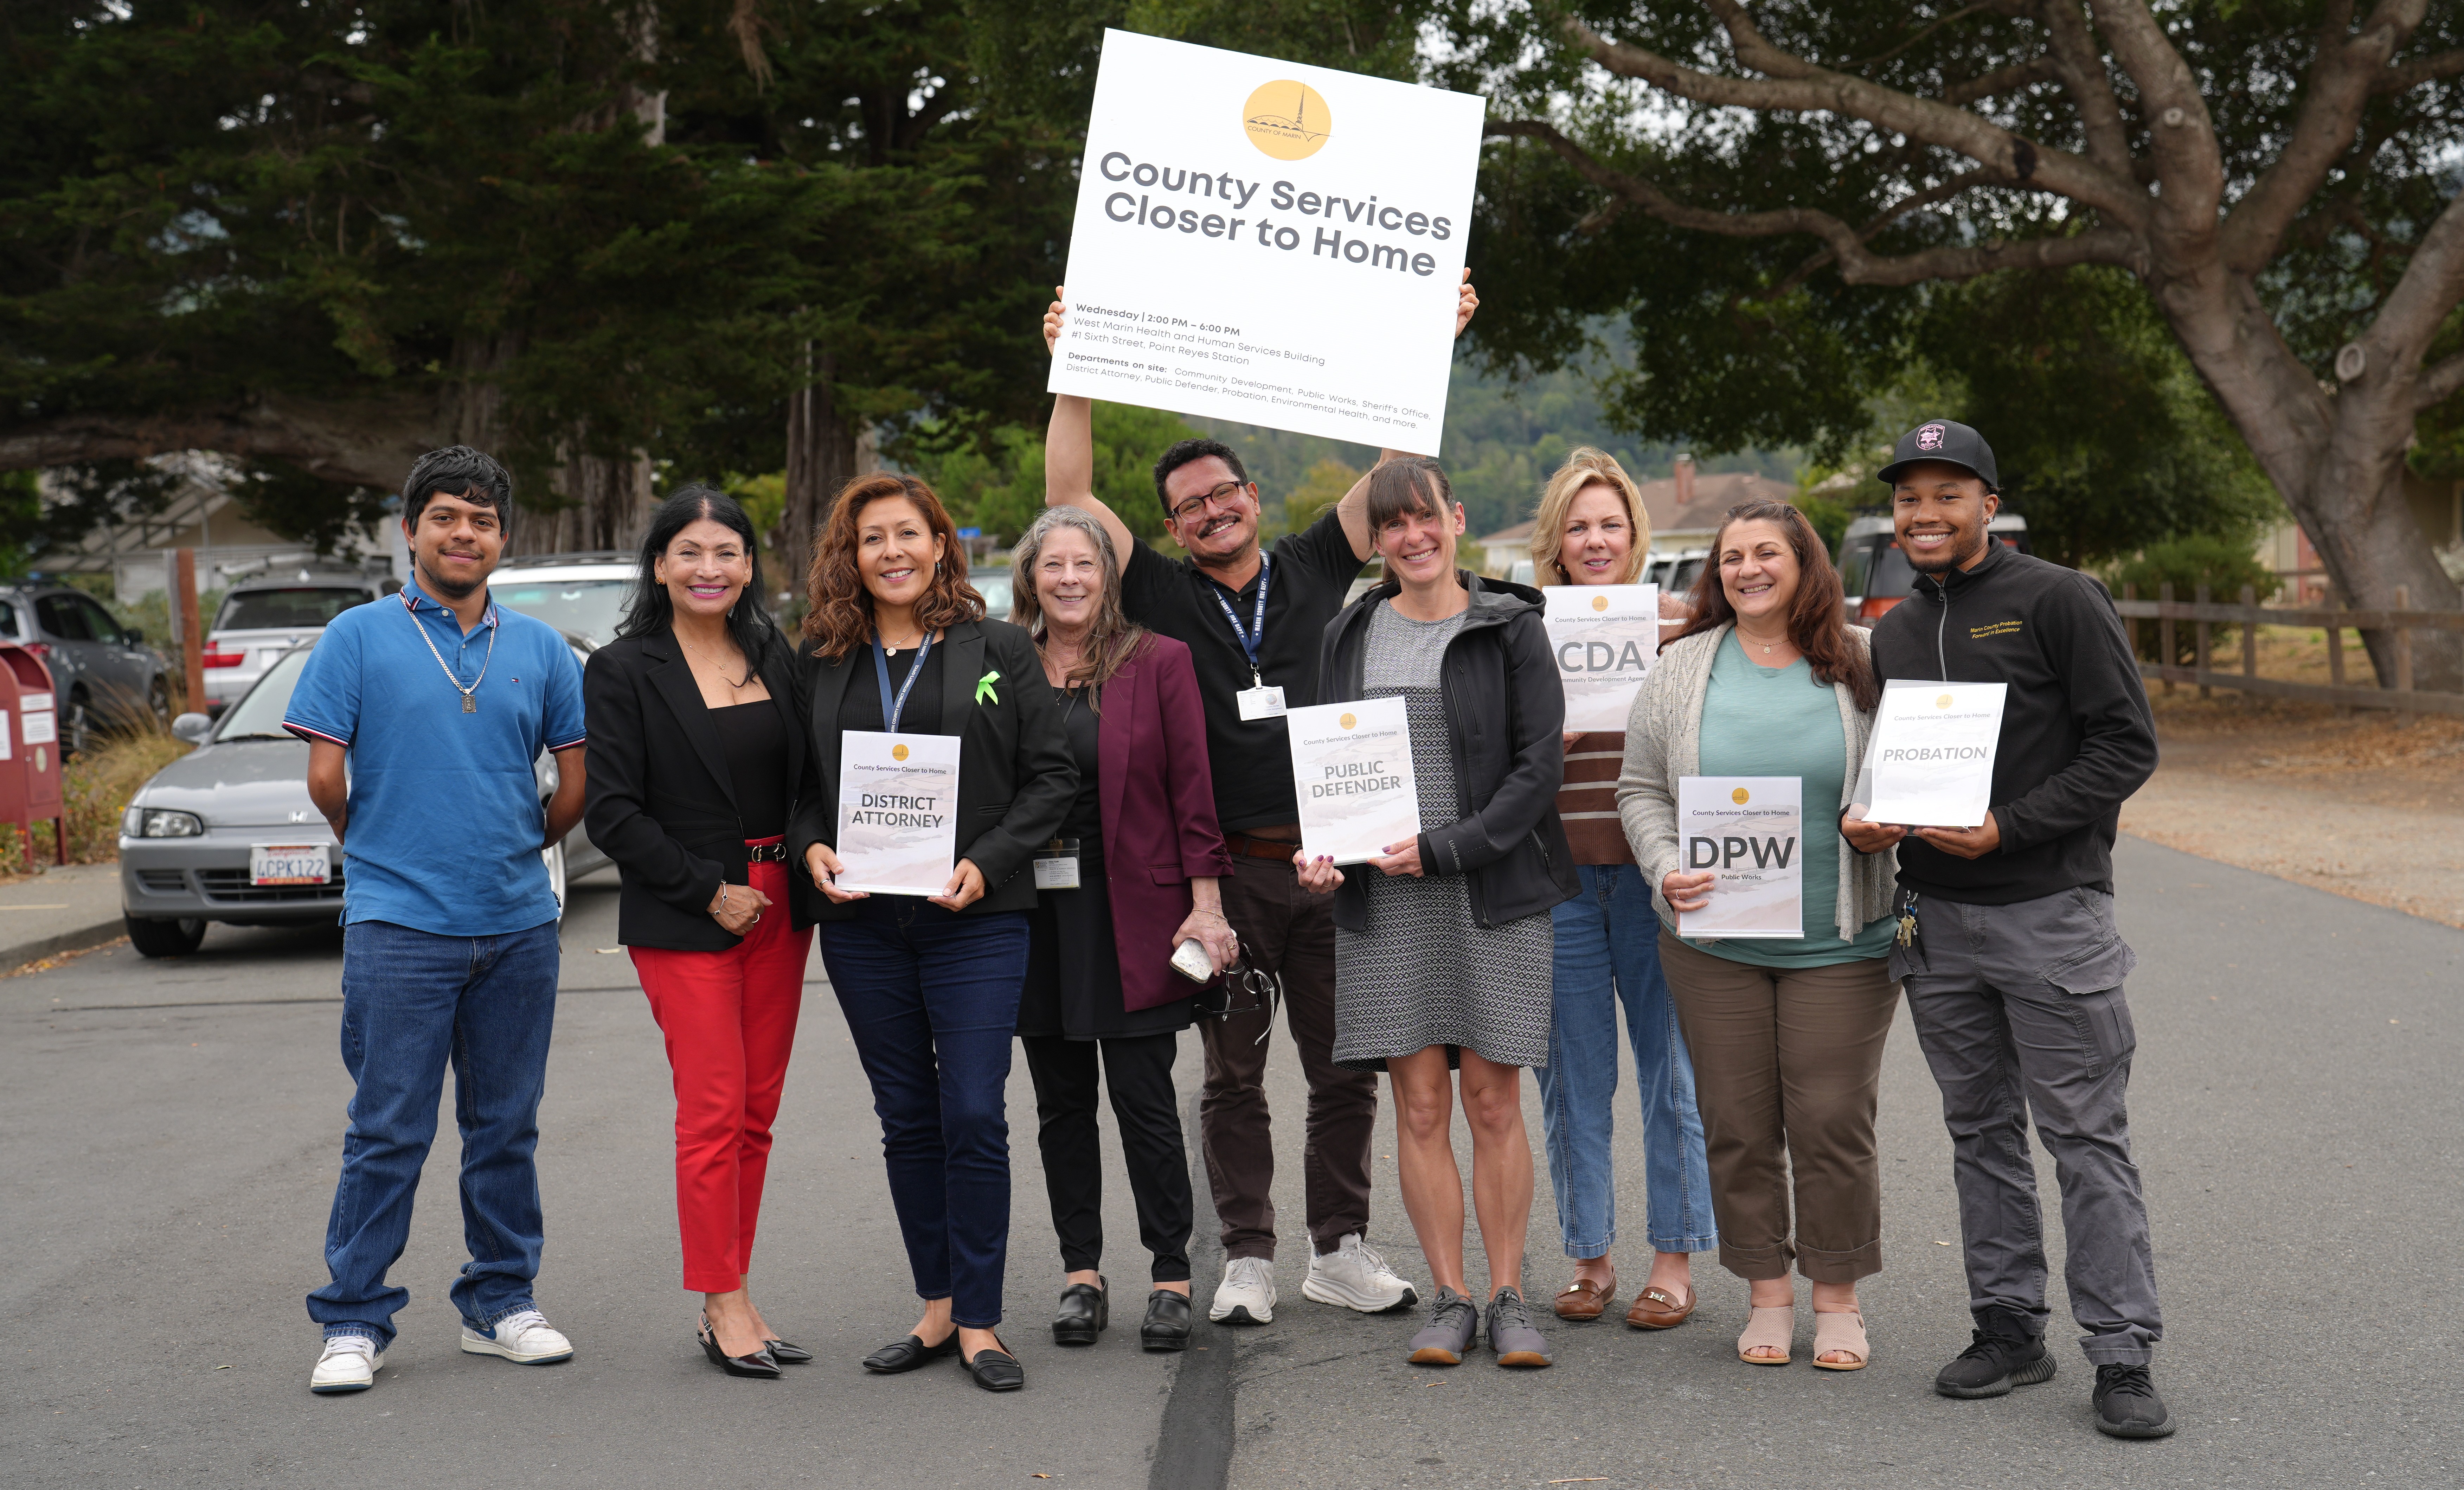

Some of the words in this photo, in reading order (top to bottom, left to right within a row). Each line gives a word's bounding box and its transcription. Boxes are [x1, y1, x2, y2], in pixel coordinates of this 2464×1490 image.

[1248, 126, 1272, 134] COUNTY
[1100, 152, 1260, 210] County
[1271, 180, 1451, 240] Services
[1105, 192, 1245, 241] Closer
[1256, 218, 1300, 250] to
[1313, 226, 1436, 276] Home
[1076, 303, 1139, 321] Wednesday
[1147, 314, 1169, 324] 2:00
[1172, 318, 1187, 327] PM
[1200, 323, 1221, 333] 6:00
[1224, 327, 1239, 336] PM
[1074, 317, 1100, 328] West
[1103, 321, 1133, 332] Marin
[1137, 326, 1170, 338] Health
[1174, 333, 1195, 342] and
[1198, 336, 1234, 349] Human
[1238, 343, 1281, 357] Services
[1284, 351, 1325, 366] Building
[1084, 332, 1109, 343] Sixth
[1112, 336, 1145, 349] Street,
[1149, 341, 1175, 353] Point
[1179, 346, 1209, 358] Reyes
[1212, 352, 1249, 365] Station
[1066, 364, 1098, 374] District
[1101, 369, 1142, 382] Attorney,
[1145, 375, 1173, 385] Public
[1175, 380, 1219, 394] Defender,
[1222, 388, 1268, 402] Probation,
[1271, 396, 1336, 414] Environmental
[1339, 408, 1369, 421] Health,
[1393, 420, 1417, 429] more.
[1068, 352, 1129, 367] Departments
[1148, 364, 1167, 373] site:
[1175, 368, 1227, 384] Community
[1231, 377, 1293, 394] Development,
[1298, 389, 1325, 399] Public
[1329, 394, 1358, 407] Works,
[1362, 401, 1398, 413] Sheriff's
[1401, 408, 1430, 420] Office,
[1220, 600, 1232, 614] COUNTY
[1230, 615, 1238, 624] FIRE
[1234, 624, 1244, 634] DEPT
[924, 633, 932, 645] COUNTY
[1558, 641, 1645, 672] CDA
[896, 693, 905, 708] DISTRICT
[902, 675, 914, 693] ATTORNEY'S
[911, 664, 919, 675] OFFICE
[1324, 760, 1385, 779] PUBLIC
[1883, 747, 1987, 761] PROBATION
[862, 794, 936, 810] DISTRICT
[1312, 776, 1401, 798] DEFENDER
[852, 811, 943, 828] ATTORNEY
[257, 859, 324, 877] 4CPK122
[1448, 840, 1461, 871] LULULEMON
[1690, 837, 1795, 869] DPW
